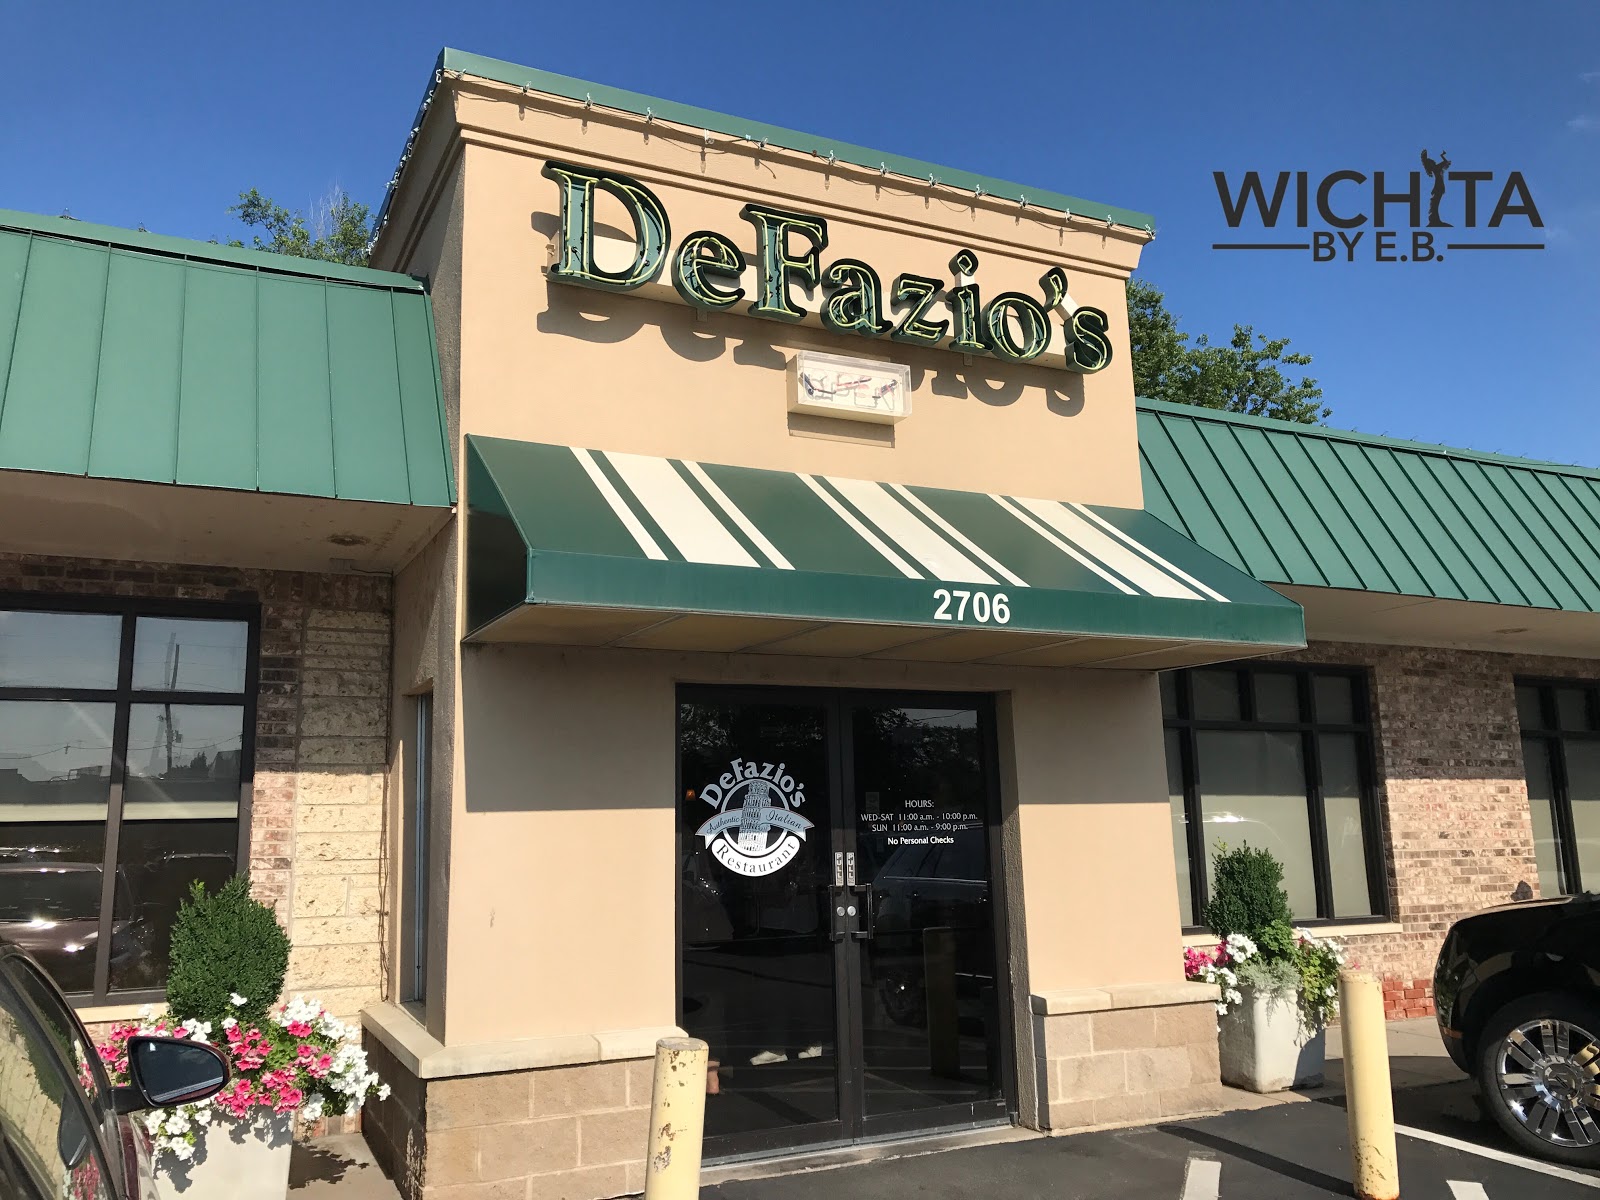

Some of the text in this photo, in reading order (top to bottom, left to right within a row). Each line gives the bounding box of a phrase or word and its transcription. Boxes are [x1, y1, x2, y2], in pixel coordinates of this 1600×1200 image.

[542, 160, 1112, 374] DeFazio's
[933, 588, 1011, 624] 2706
[699, 758, 806, 809] DeFazio's
[905, 800, 934, 808] HOURS:
[707, 810, 802, 834] Authentic Italian
[860, 813, 894, 822] WED-SAT
[898, 813, 918, 821] 11:00
[920, 812, 935, 820] a.m.
[942, 812, 961, 820] 10:00
[962, 812, 978, 822] p.m.
[872, 823, 888, 832] SUN
[892, 823, 912, 832] 11:00
[914, 823, 929, 831] a.m.
[935, 822, 951, 831] 9:00
[887, 835, 954, 846] No Personal Checks
[716, 842, 796, 873] Restaurant
